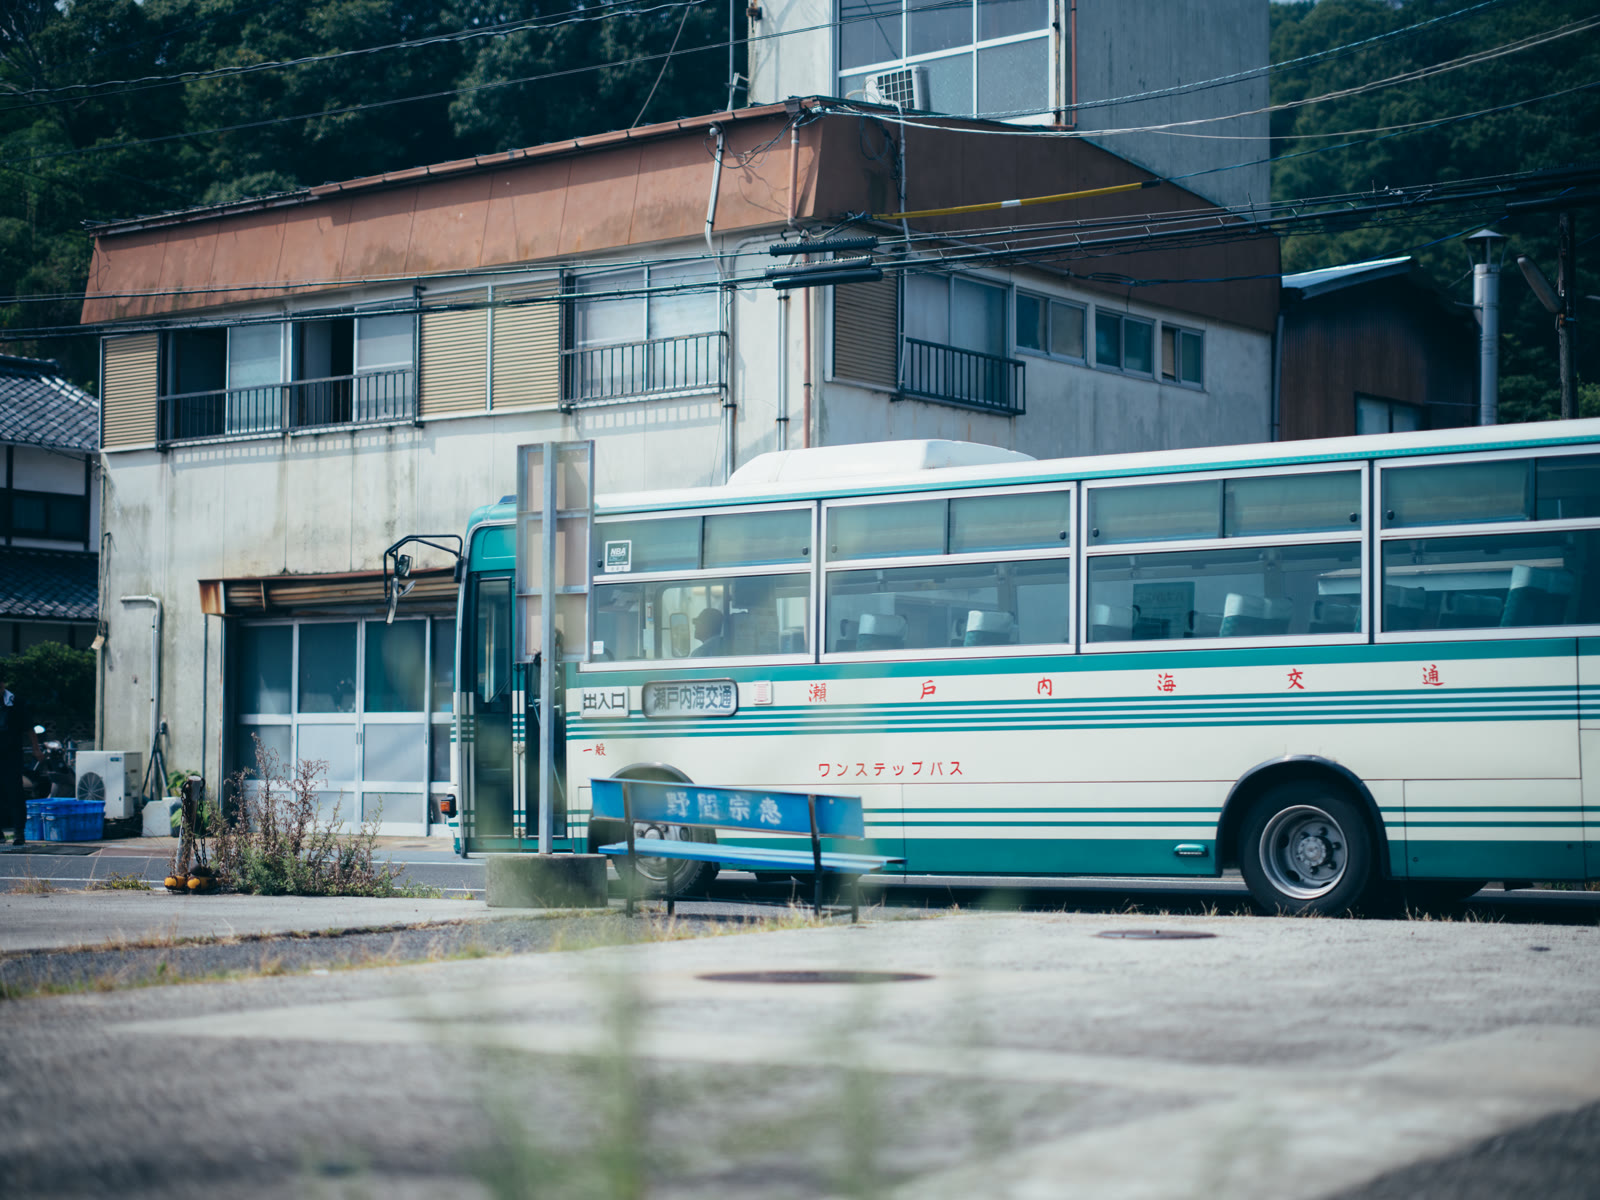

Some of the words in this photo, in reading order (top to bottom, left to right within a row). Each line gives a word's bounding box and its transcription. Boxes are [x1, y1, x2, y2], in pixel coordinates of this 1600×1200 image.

[610, 547, 626, 556] NBA
[808, 664, 1445, 702] 瀬戸内海交通
[583, 692, 625, 710] 出入口
[653, 684, 732, 710] 瀬戸内海交通
[583, 743, 606, 756] 一般
[818, 761, 963, 777] ワンステップバス
